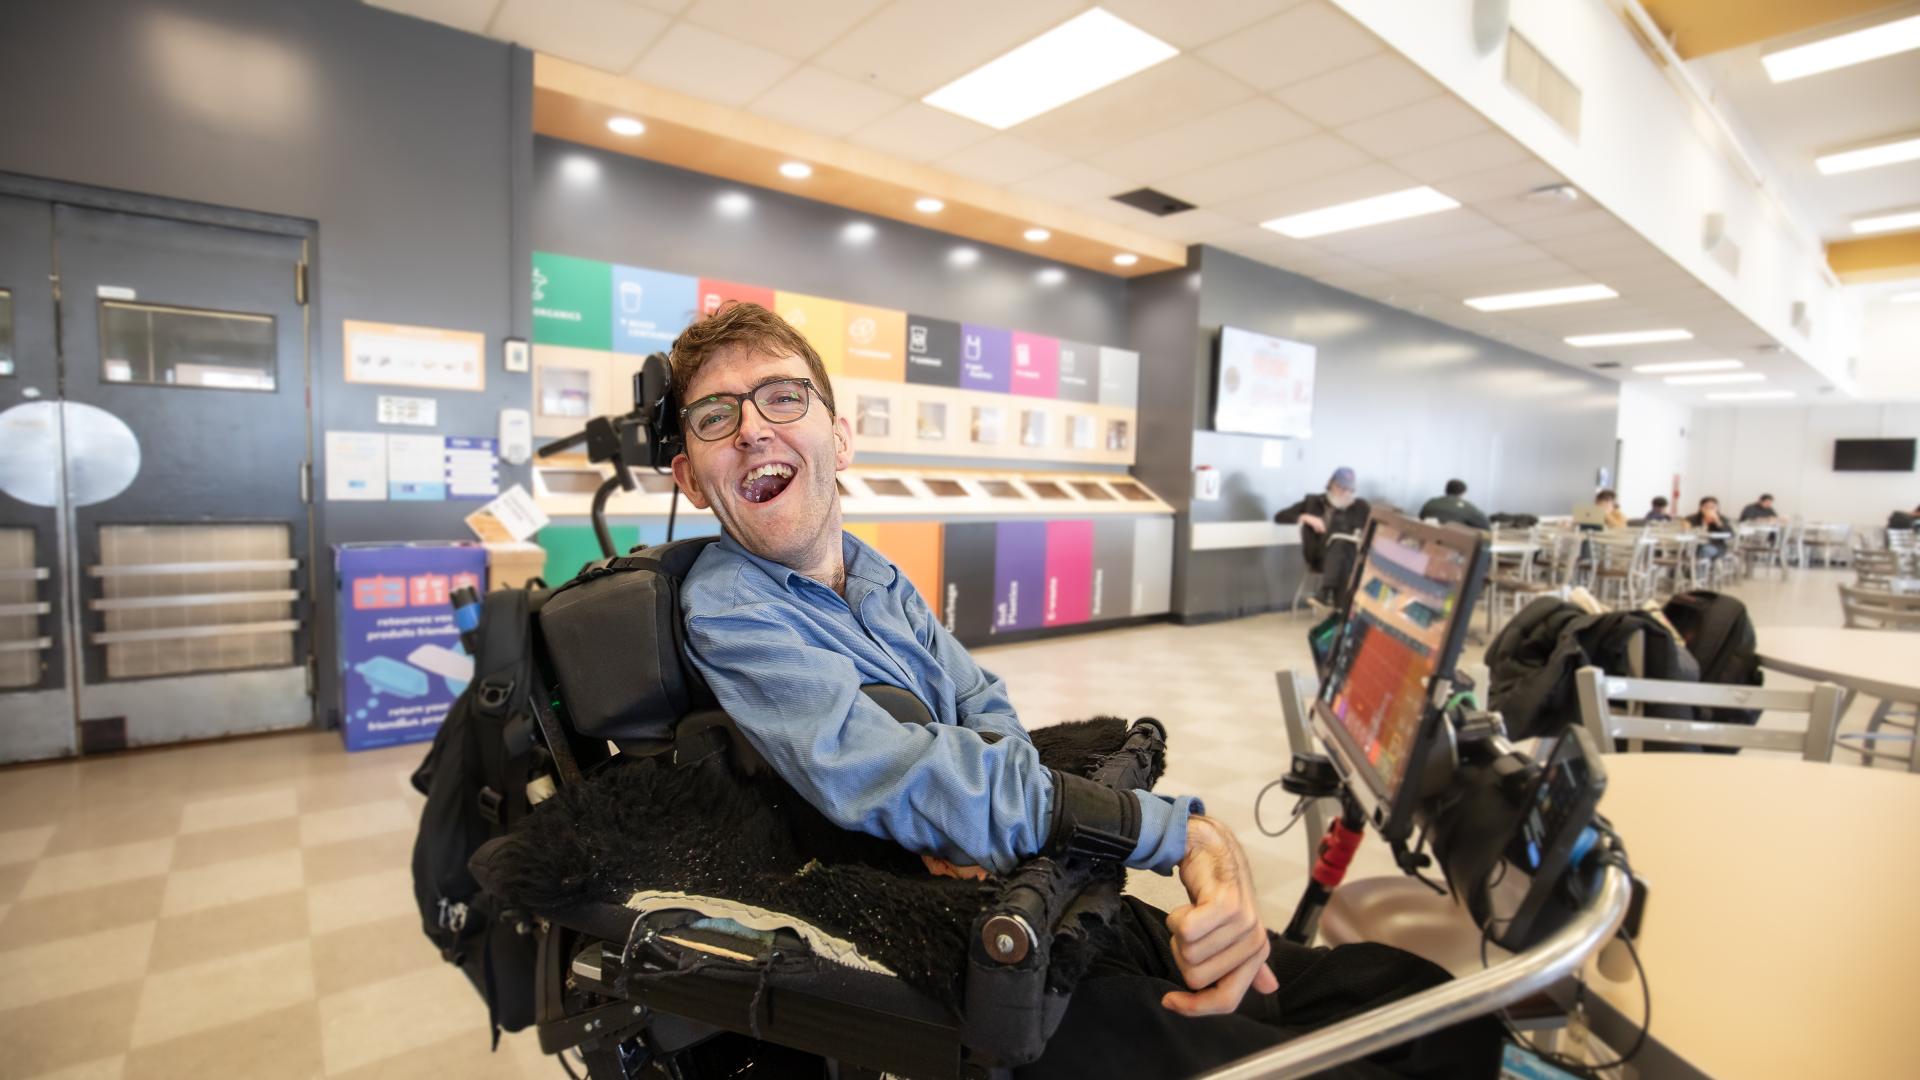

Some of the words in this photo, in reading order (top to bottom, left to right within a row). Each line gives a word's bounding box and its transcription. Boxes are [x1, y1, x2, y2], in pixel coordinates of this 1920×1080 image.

[945, 583, 958, 632] Garbage
[1008, 580, 1019, 624] Plastics
[366, 627, 416, 641] produits
[388, 706, 423, 717] return
